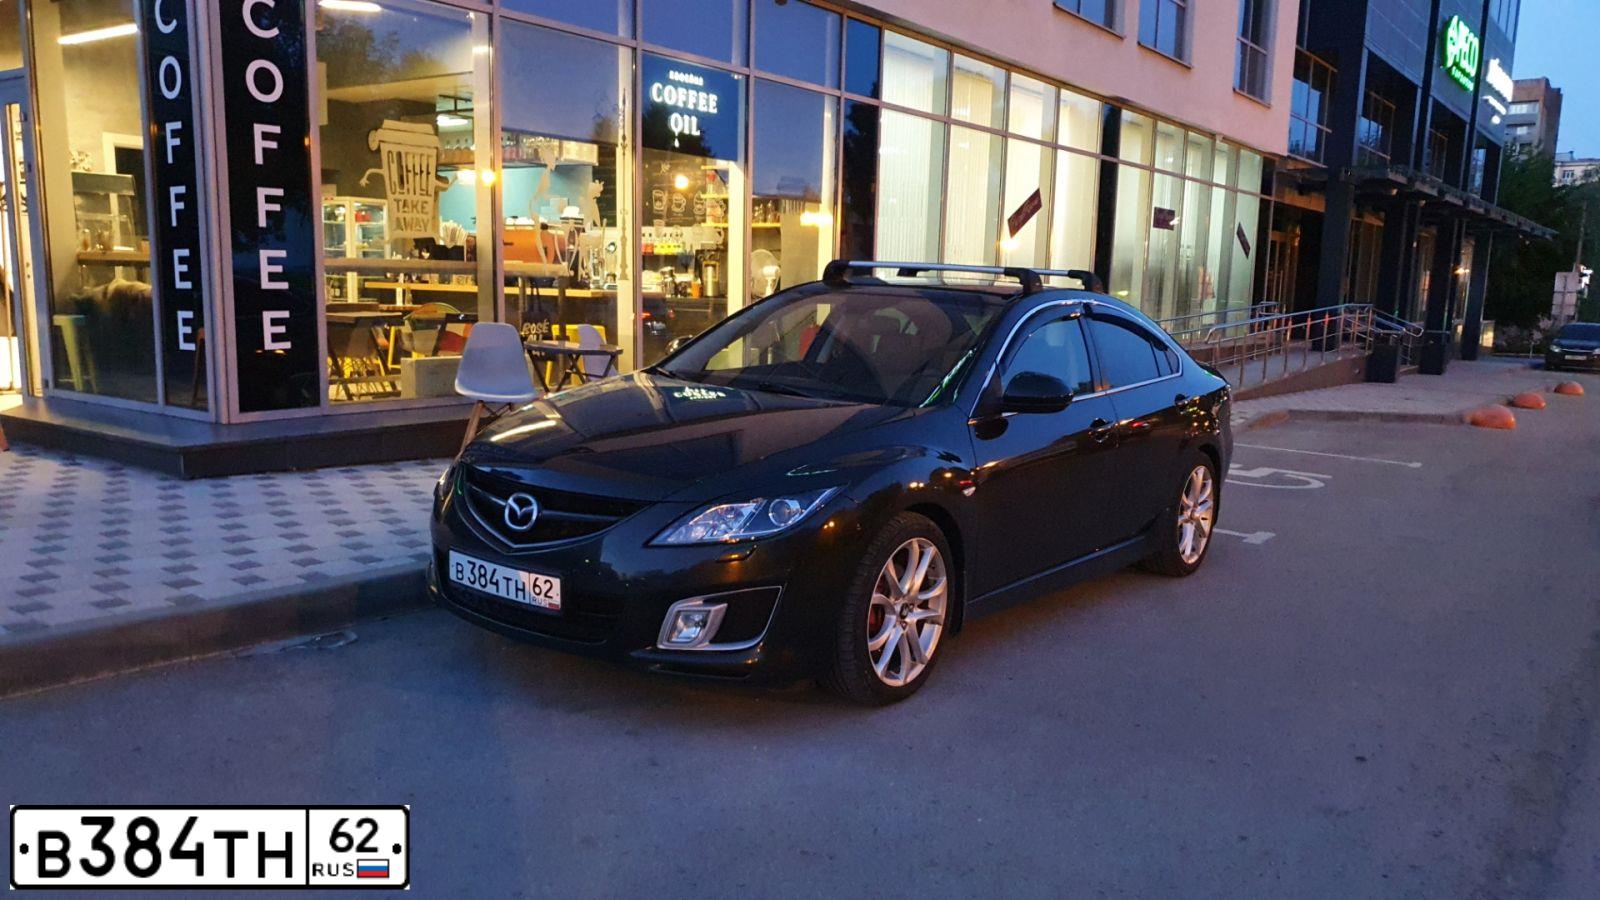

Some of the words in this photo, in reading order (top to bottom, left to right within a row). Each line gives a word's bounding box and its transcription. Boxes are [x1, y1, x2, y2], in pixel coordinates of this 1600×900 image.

[650, 82, 718, 114] COFFEE
[670, 112, 701, 137] OIL
[155, 0, 196, 351] COFFEE
[242, 0, 292, 351] COFFEE
[387, 150, 433, 197] COFFEE
[393, 199, 430, 215] TAKE
[396, 216, 430, 233] AWAY
[455, 560, 526, 600] В384ТН
[532, 577, 554, 599] 62
